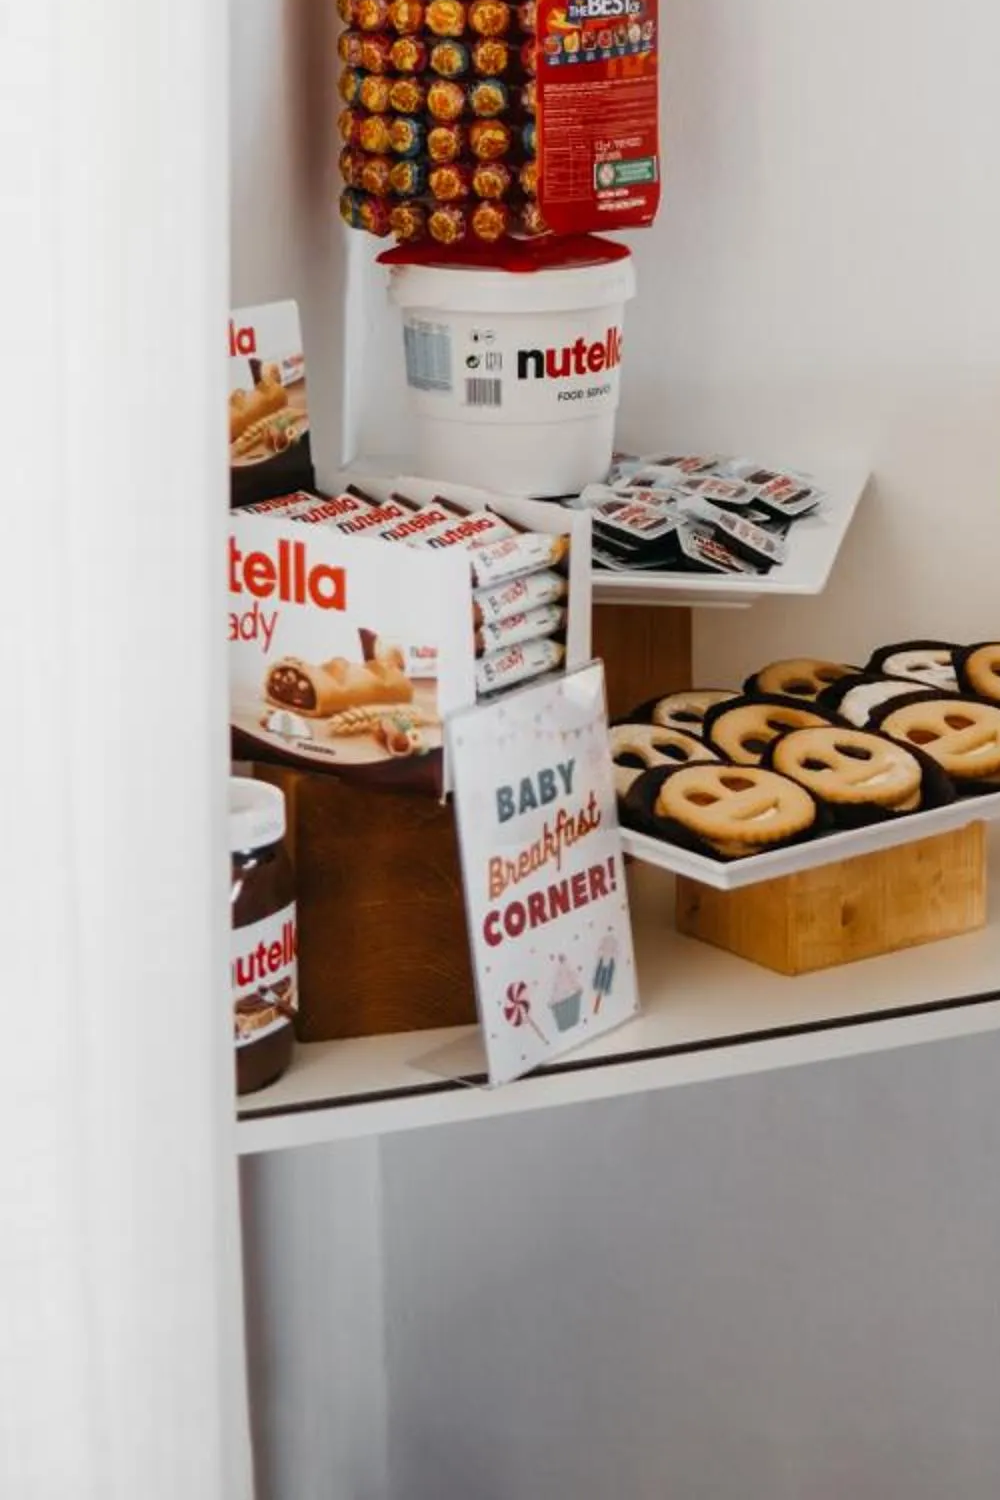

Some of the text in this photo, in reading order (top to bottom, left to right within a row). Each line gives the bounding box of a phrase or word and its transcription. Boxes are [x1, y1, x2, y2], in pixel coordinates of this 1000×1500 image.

[557, 390, 584, 401] FOOD
[228, 534, 346, 611] tella
[496, 757, 575, 824] BABY
[488, 789, 602, 901] Breakfast
[483, 856, 617, 947] CORNER!
[232, 920, 297, 989] utell
